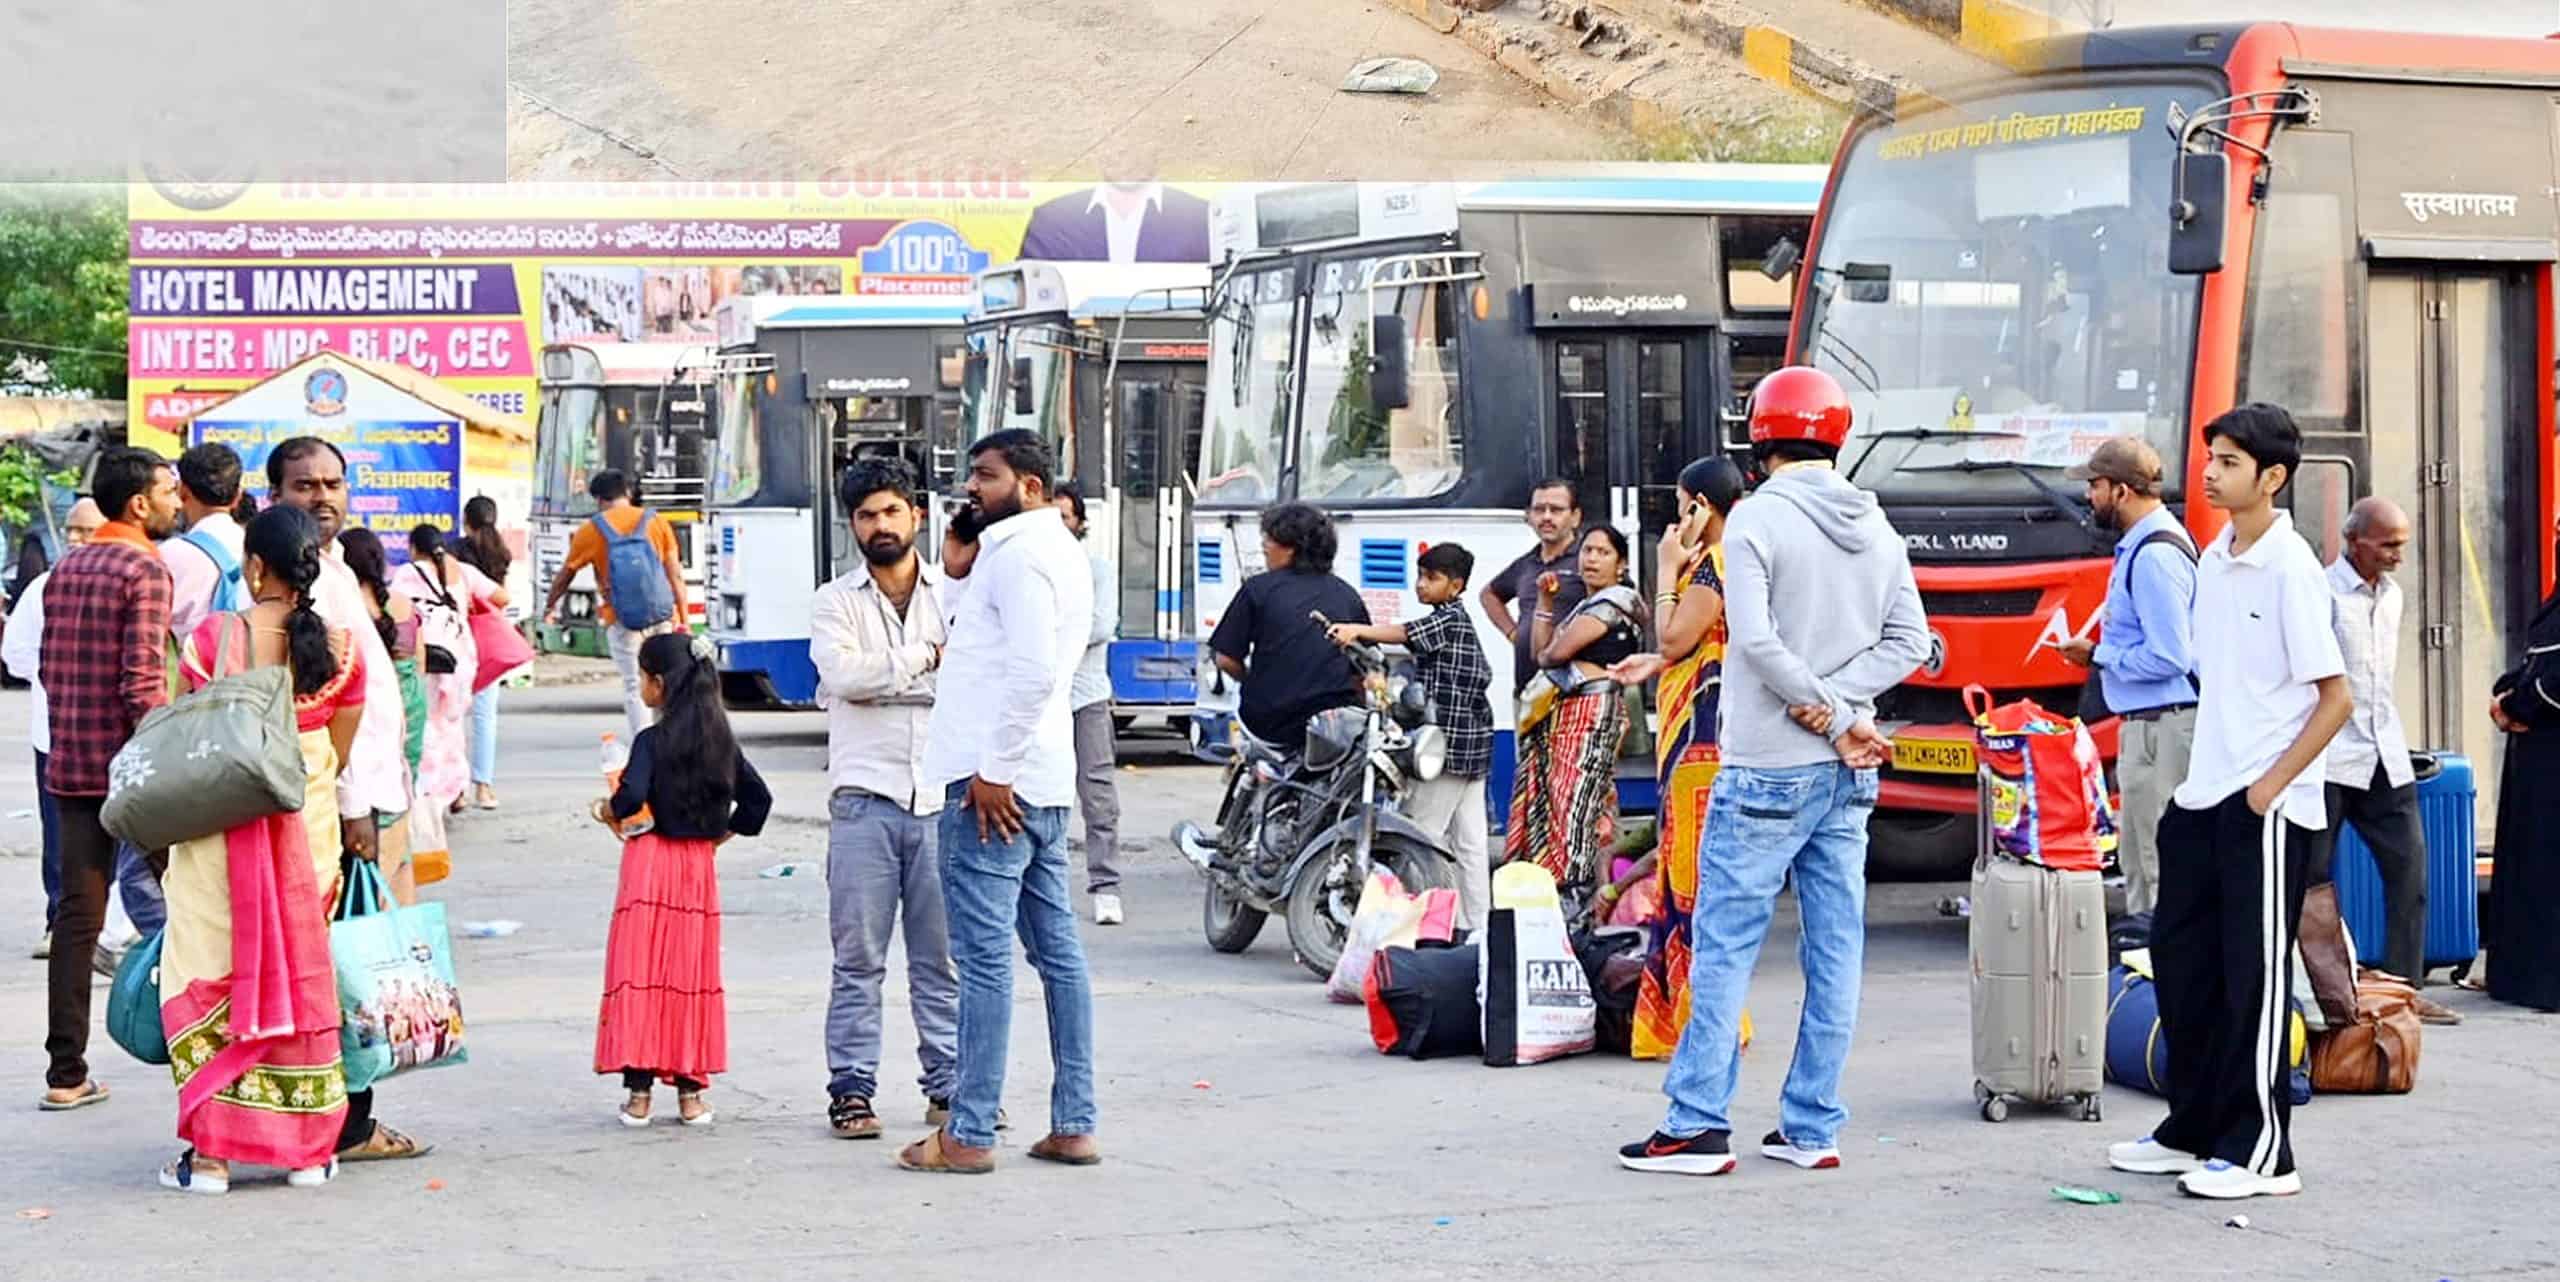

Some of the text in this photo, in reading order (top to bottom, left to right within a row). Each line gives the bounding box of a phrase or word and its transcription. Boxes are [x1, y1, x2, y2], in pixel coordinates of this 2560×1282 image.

[2063, 101, 2145, 137] महामंडळ
[889, 234, 969, 273] 100%
[140, 268, 479, 311] HOTEL MANAGEMENT
[140, 329, 236, 369] INTER
[447, 326, 513, 369] CEC
